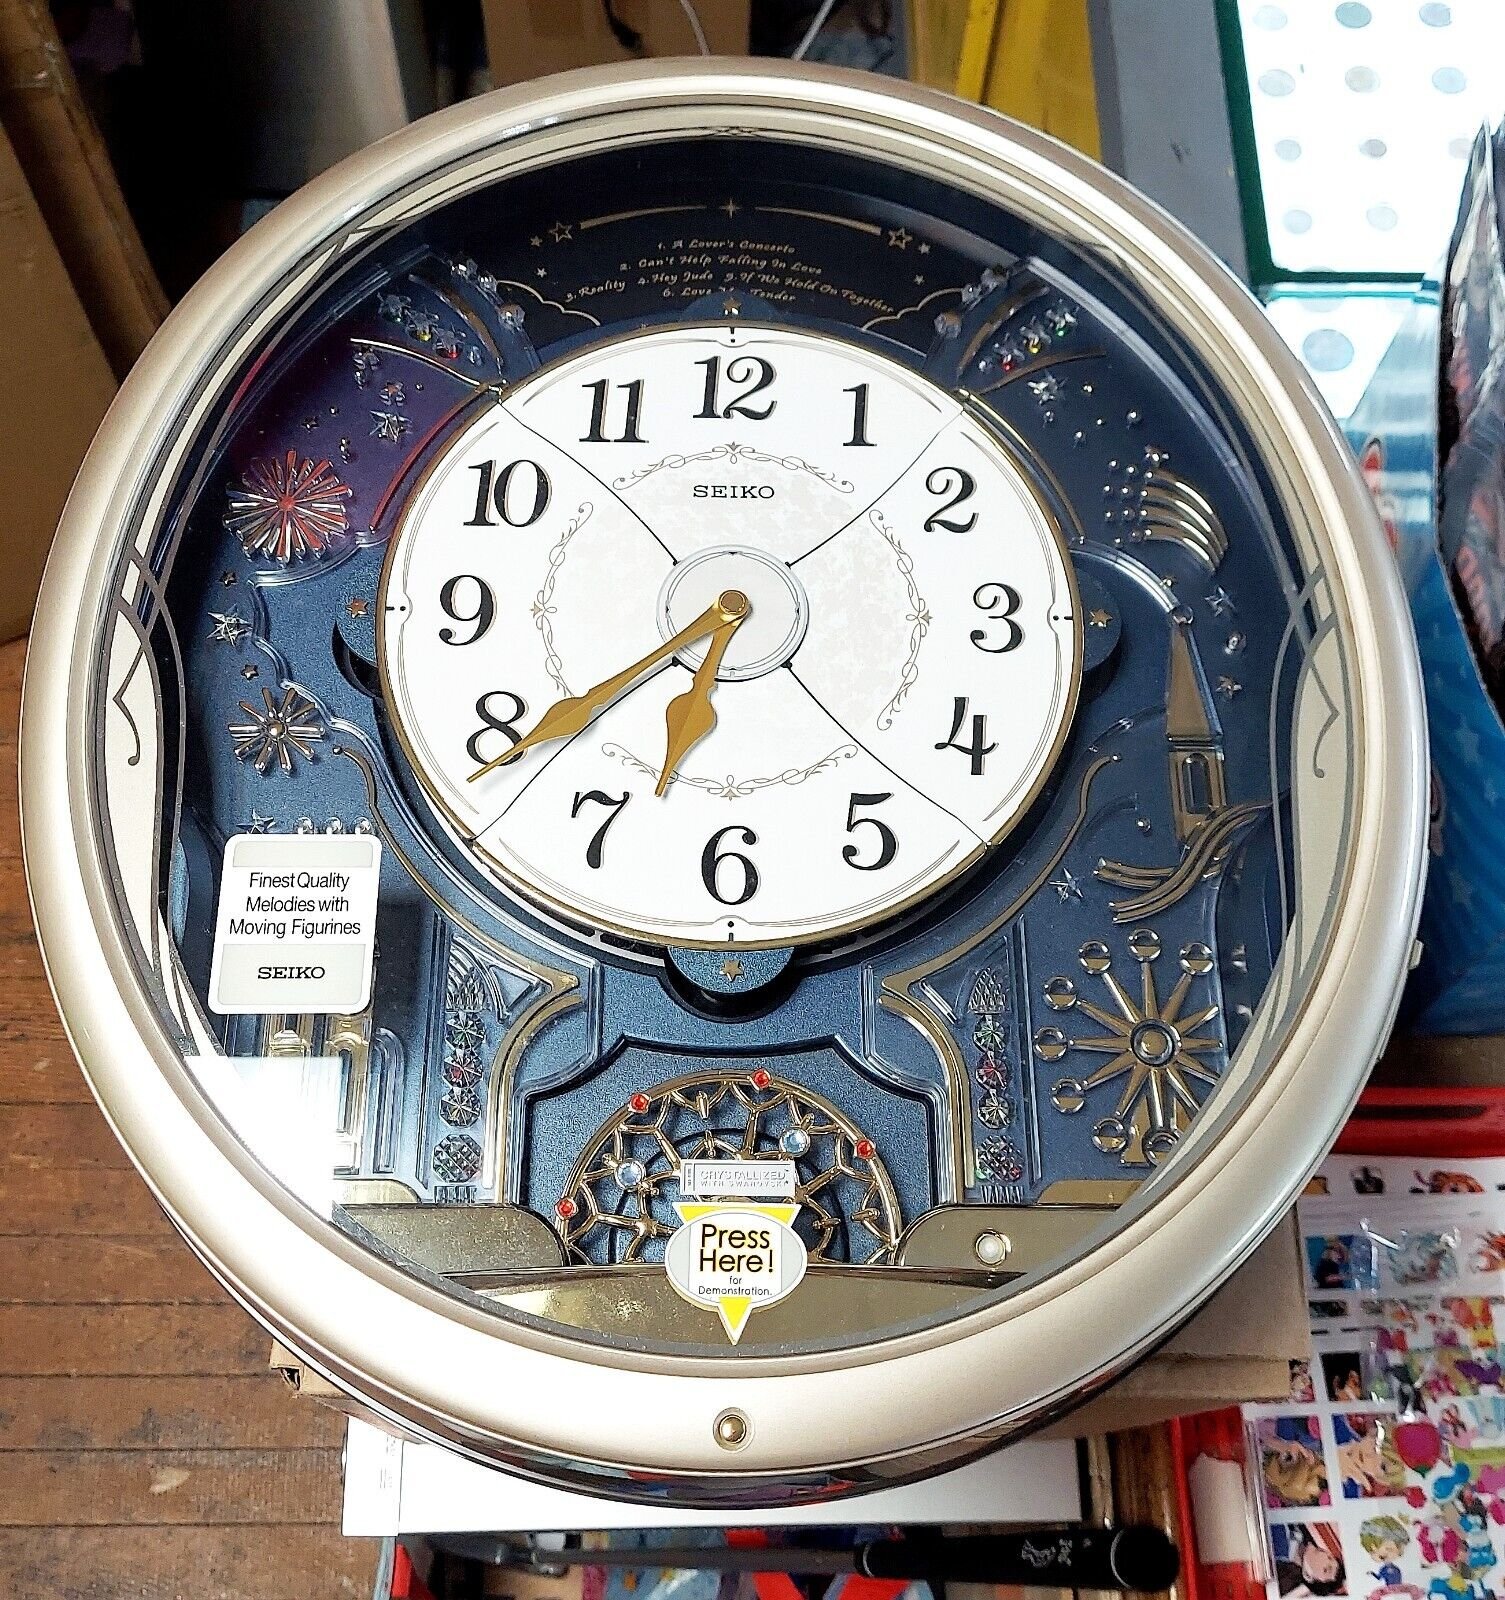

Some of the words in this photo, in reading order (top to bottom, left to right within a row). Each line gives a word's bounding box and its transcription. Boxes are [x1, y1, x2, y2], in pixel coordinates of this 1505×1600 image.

[638, 256, 675, 268] Can't
[679, 254, 712, 267] Help
[718, 254, 767, 269] Falling
[791, 261, 822, 275] Love
[671, 240, 683, 249] A
[688, 239, 734, 249] Lover's
[739, 240, 796, 253] Concerto
[578, 280, 625, 297] Reality
[683, 270, 713, 282] Jude
[758, 273, 780, 284] We
[784, 277, 819, 291] Hold
[819, 284, 838, 295] On
[841, 289, 894, 313] Together
[681, 287, 712, 296] Love
[750, 288, 796, 300] Tender
[579, 379, 648, 443] 11
[693, 354, 777, 420] 12
[843, 383, 876, 447] 1
[463, 459, 551, 528] 10
[693, 485, 774, 498] SEIKO
[924, 467, 976, 533] 2
[438, 575, 493, 646] 9
[970, 583, 1022, 653] 3
[467, 691, 526, 766] 8
[934, 697, 997, 775] 4
[572, 790, 630, 869] 7
[842, 793, 899, 871] 5
[249, 872, 296, 888] Finest
[297, 872, 350, 892] Quality
[701, 826, 759, 905] 6
[229, 918, 287, 938] Moving
[291, 918, 361, 938] Figurines
[246, 896, 316, 912] Melodies
[318, 896, 349, 912] with
[257, 966, 325, 979] SEIKO
[701, 1223, 770, 1250] Press
[698, 1285, 773, 1296] Demonstration.
[729, 1275, 742, 1285] for
